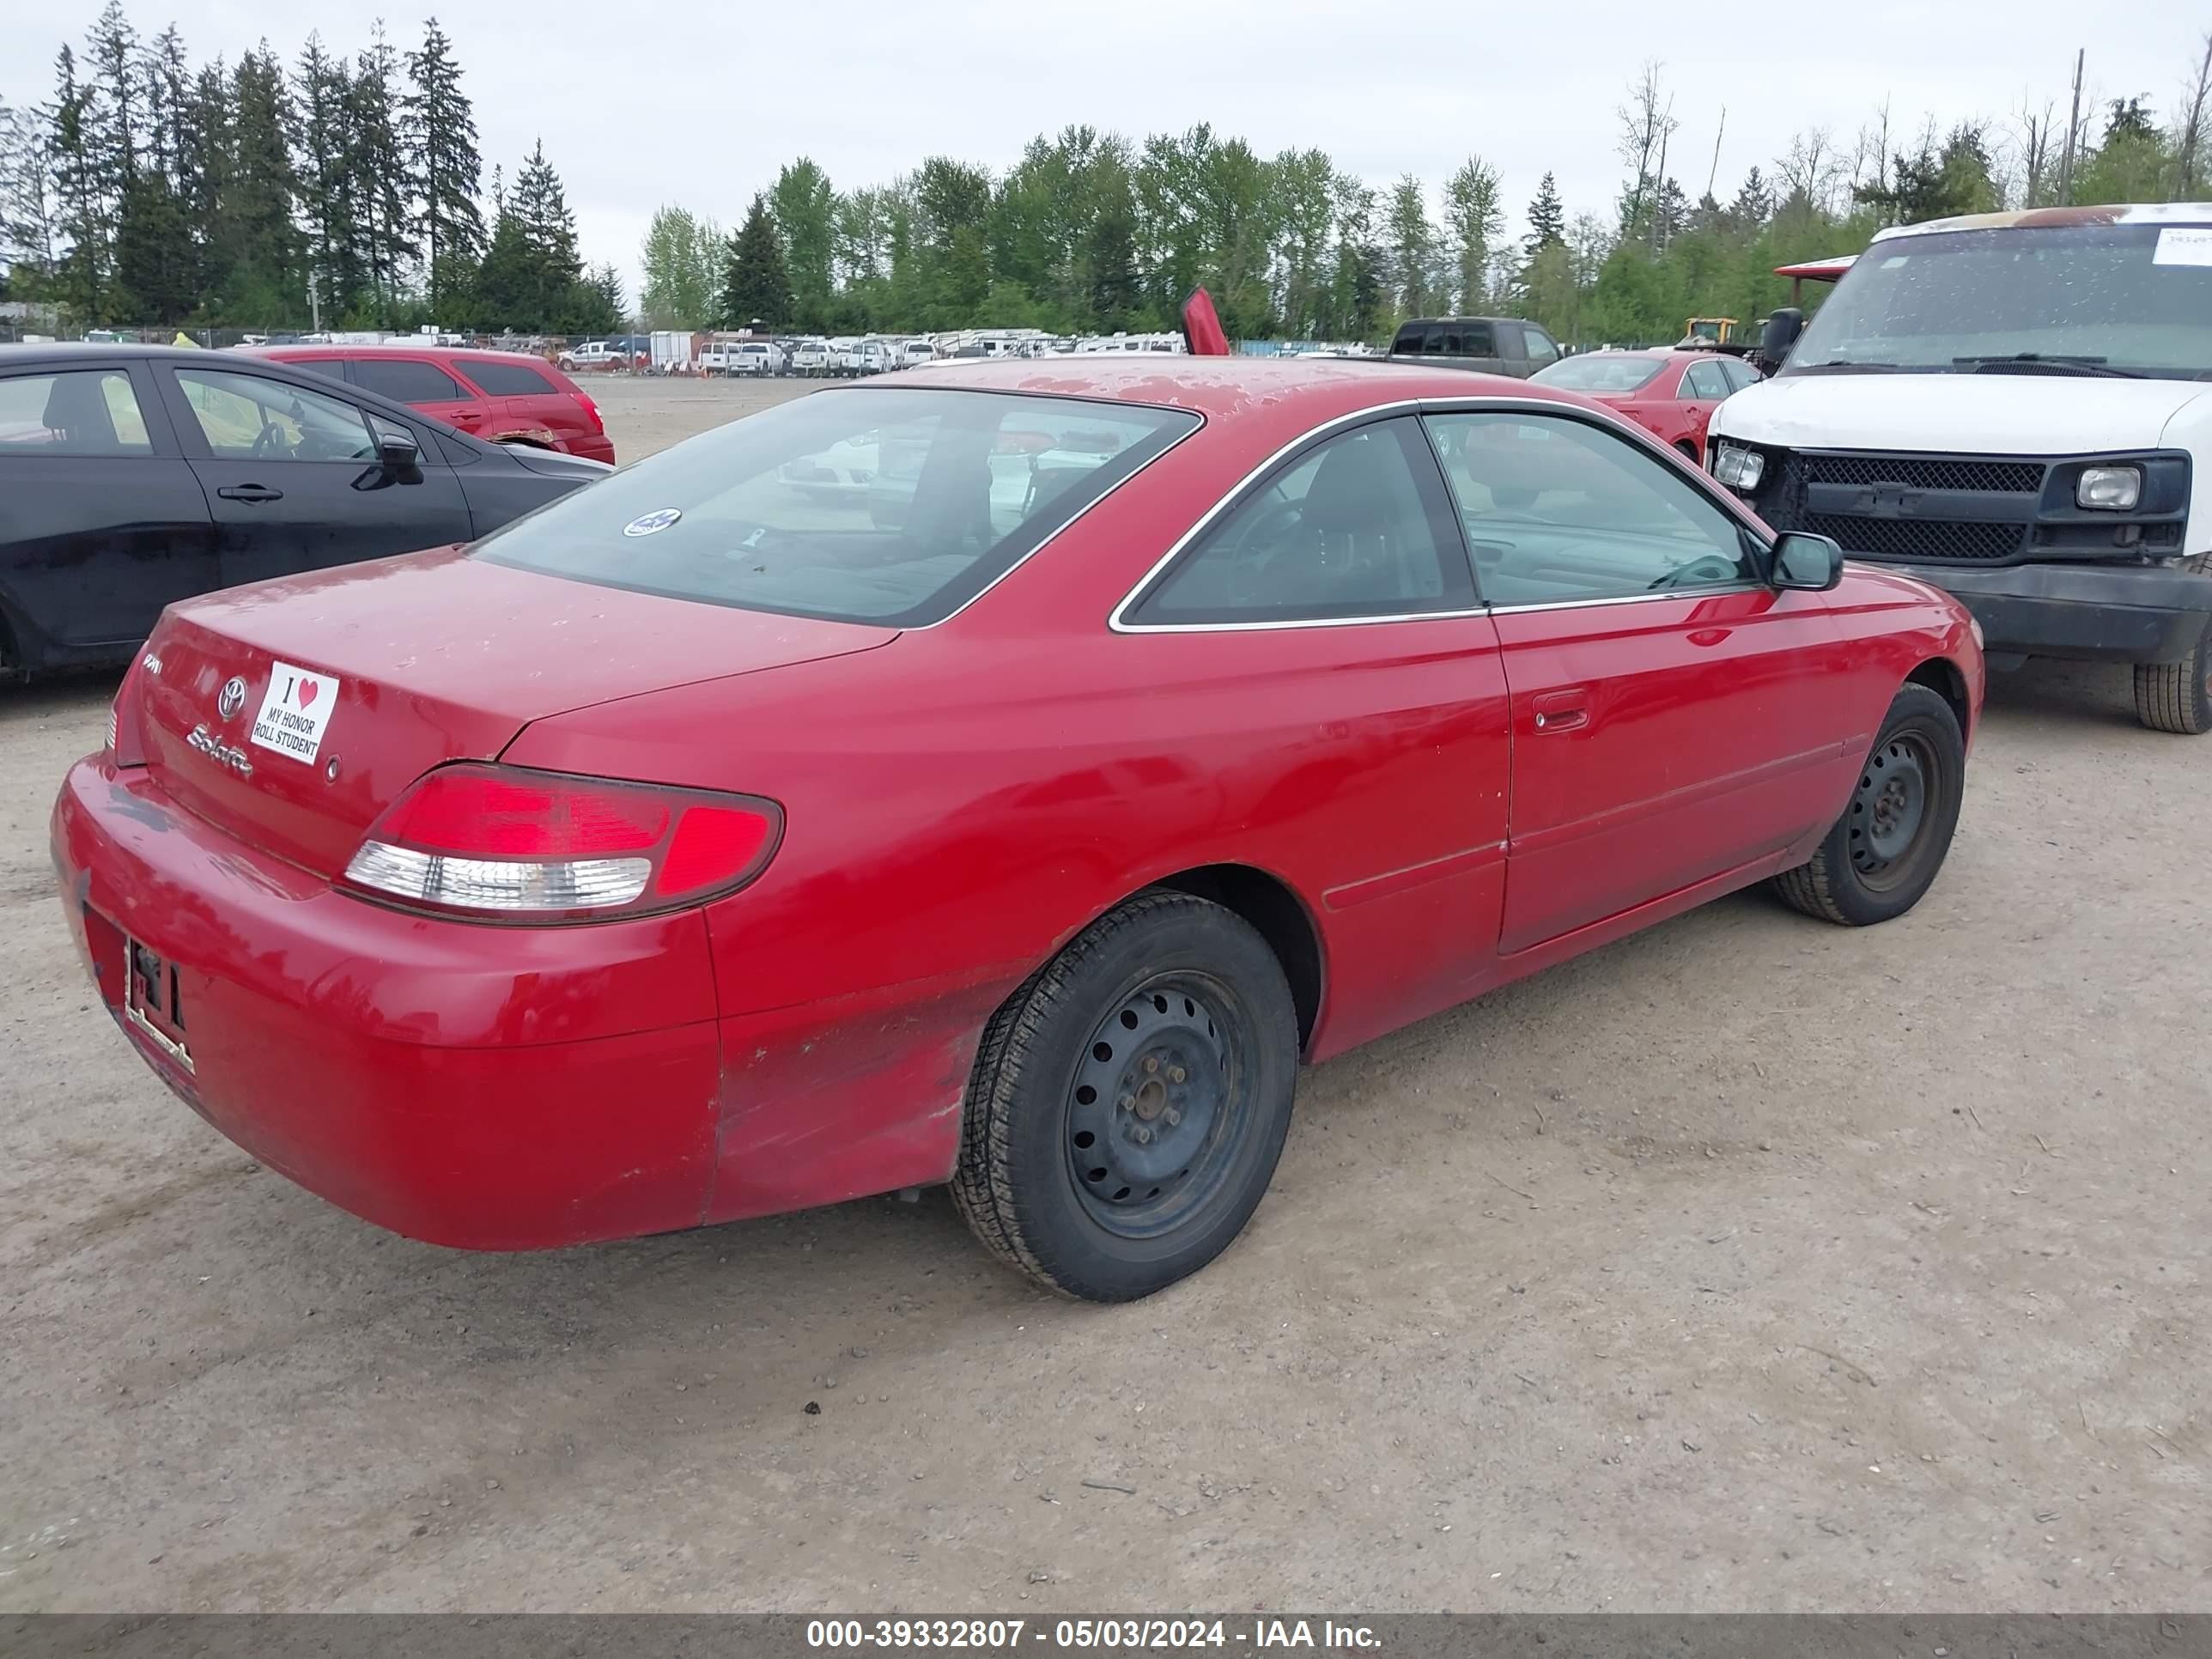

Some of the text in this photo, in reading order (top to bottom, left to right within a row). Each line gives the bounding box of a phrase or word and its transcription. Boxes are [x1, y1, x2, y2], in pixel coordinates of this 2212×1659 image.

[282, 677, 295, 704] I
[266, 707, 316, 736] MY HONOR
[186, 723, 253, 775] Solara
[253, 722, 319, 757] ROLL STUDENT
